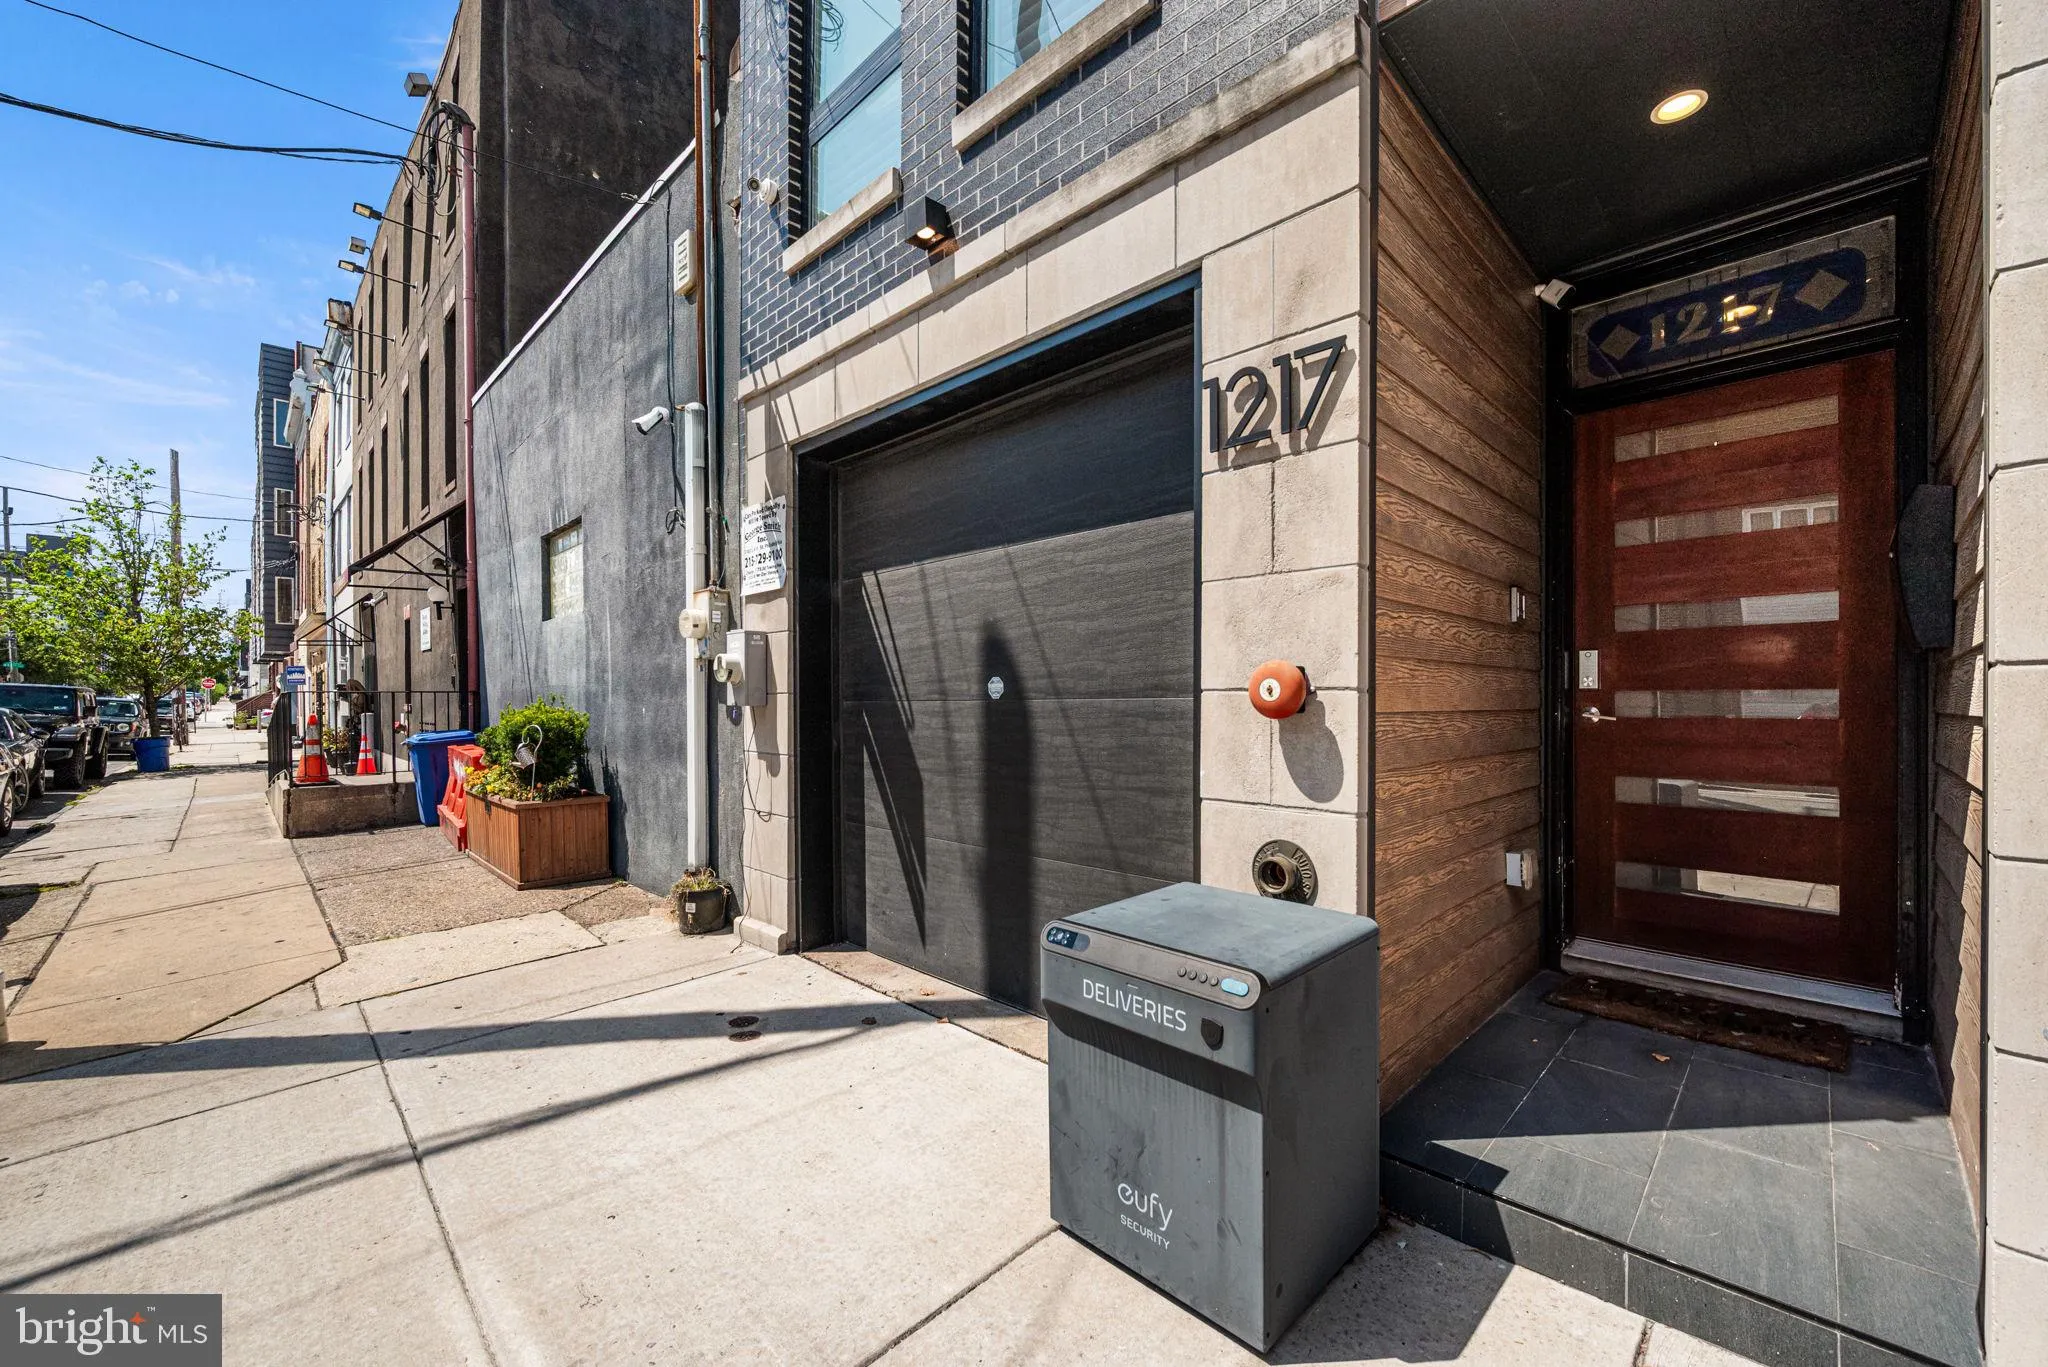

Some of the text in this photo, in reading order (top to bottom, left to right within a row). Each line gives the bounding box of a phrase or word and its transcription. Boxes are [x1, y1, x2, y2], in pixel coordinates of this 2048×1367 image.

[1650, 281, 1784, 352] 1217
[1201, 334, 1347, 453] 1217
[763, 521, 782, 531] Smith
[1083, 978, 1187, 1032] DELIVERIES
[1117, 1183, 1173, 1232] eufy
[1120, 1213, 1170, 1250] SECURITY
